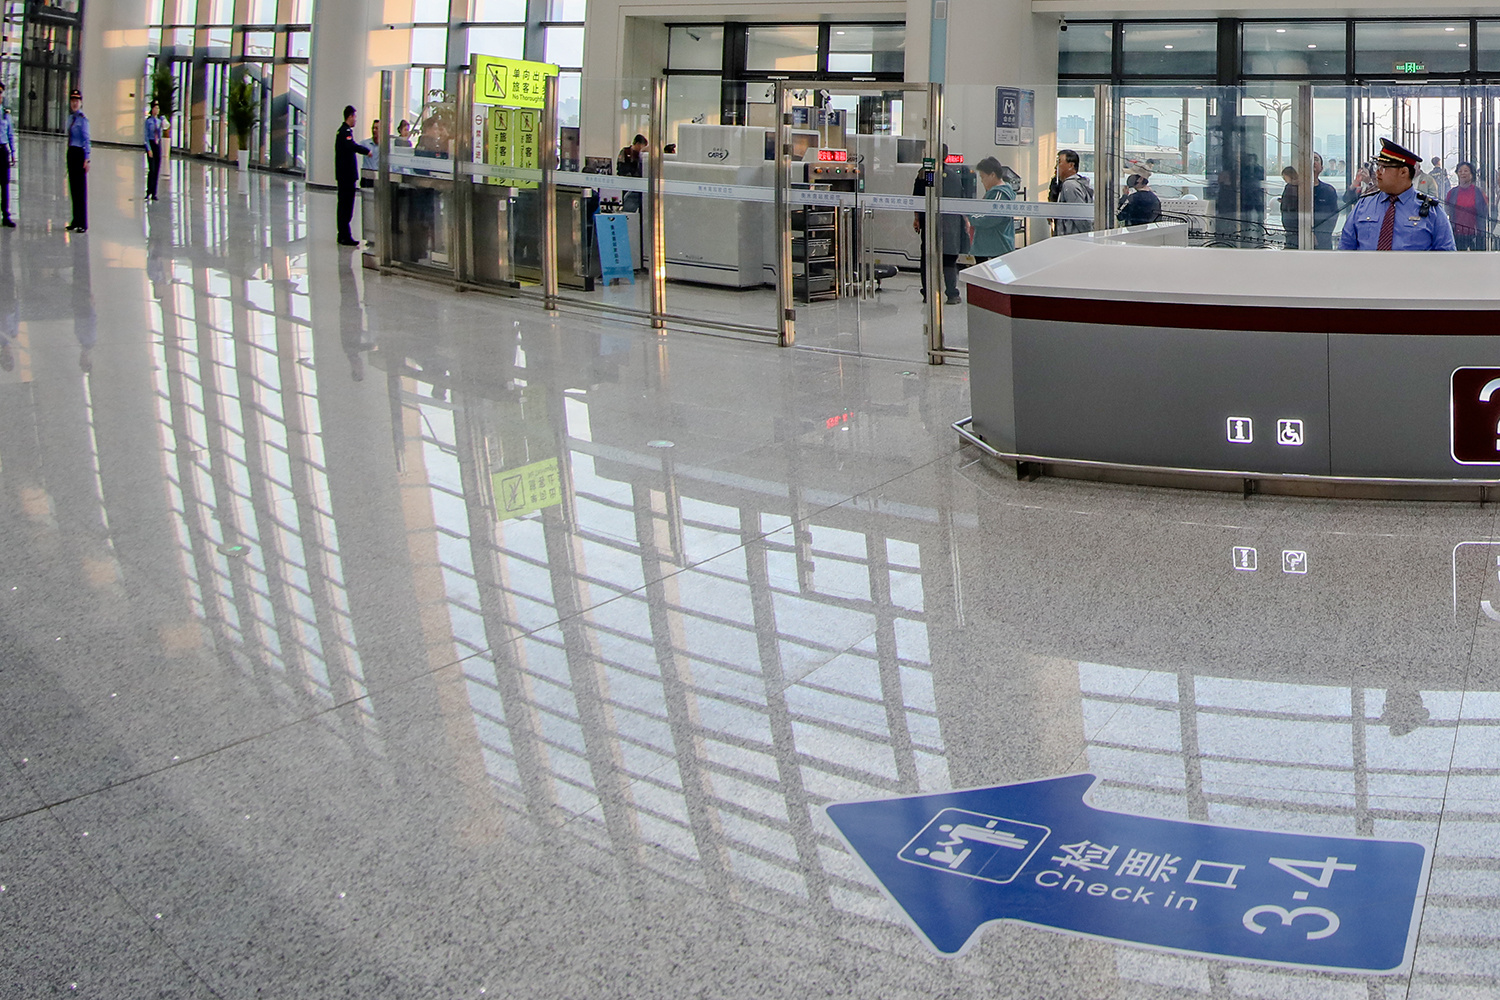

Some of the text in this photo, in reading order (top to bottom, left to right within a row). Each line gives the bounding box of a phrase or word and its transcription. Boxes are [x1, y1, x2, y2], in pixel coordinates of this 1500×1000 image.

[992, 203, 1040, 212] 衡水南站欢迎您
[1051, 838, 1245, 889] 检票口
[1035, 869, 1198, 911] Check in
